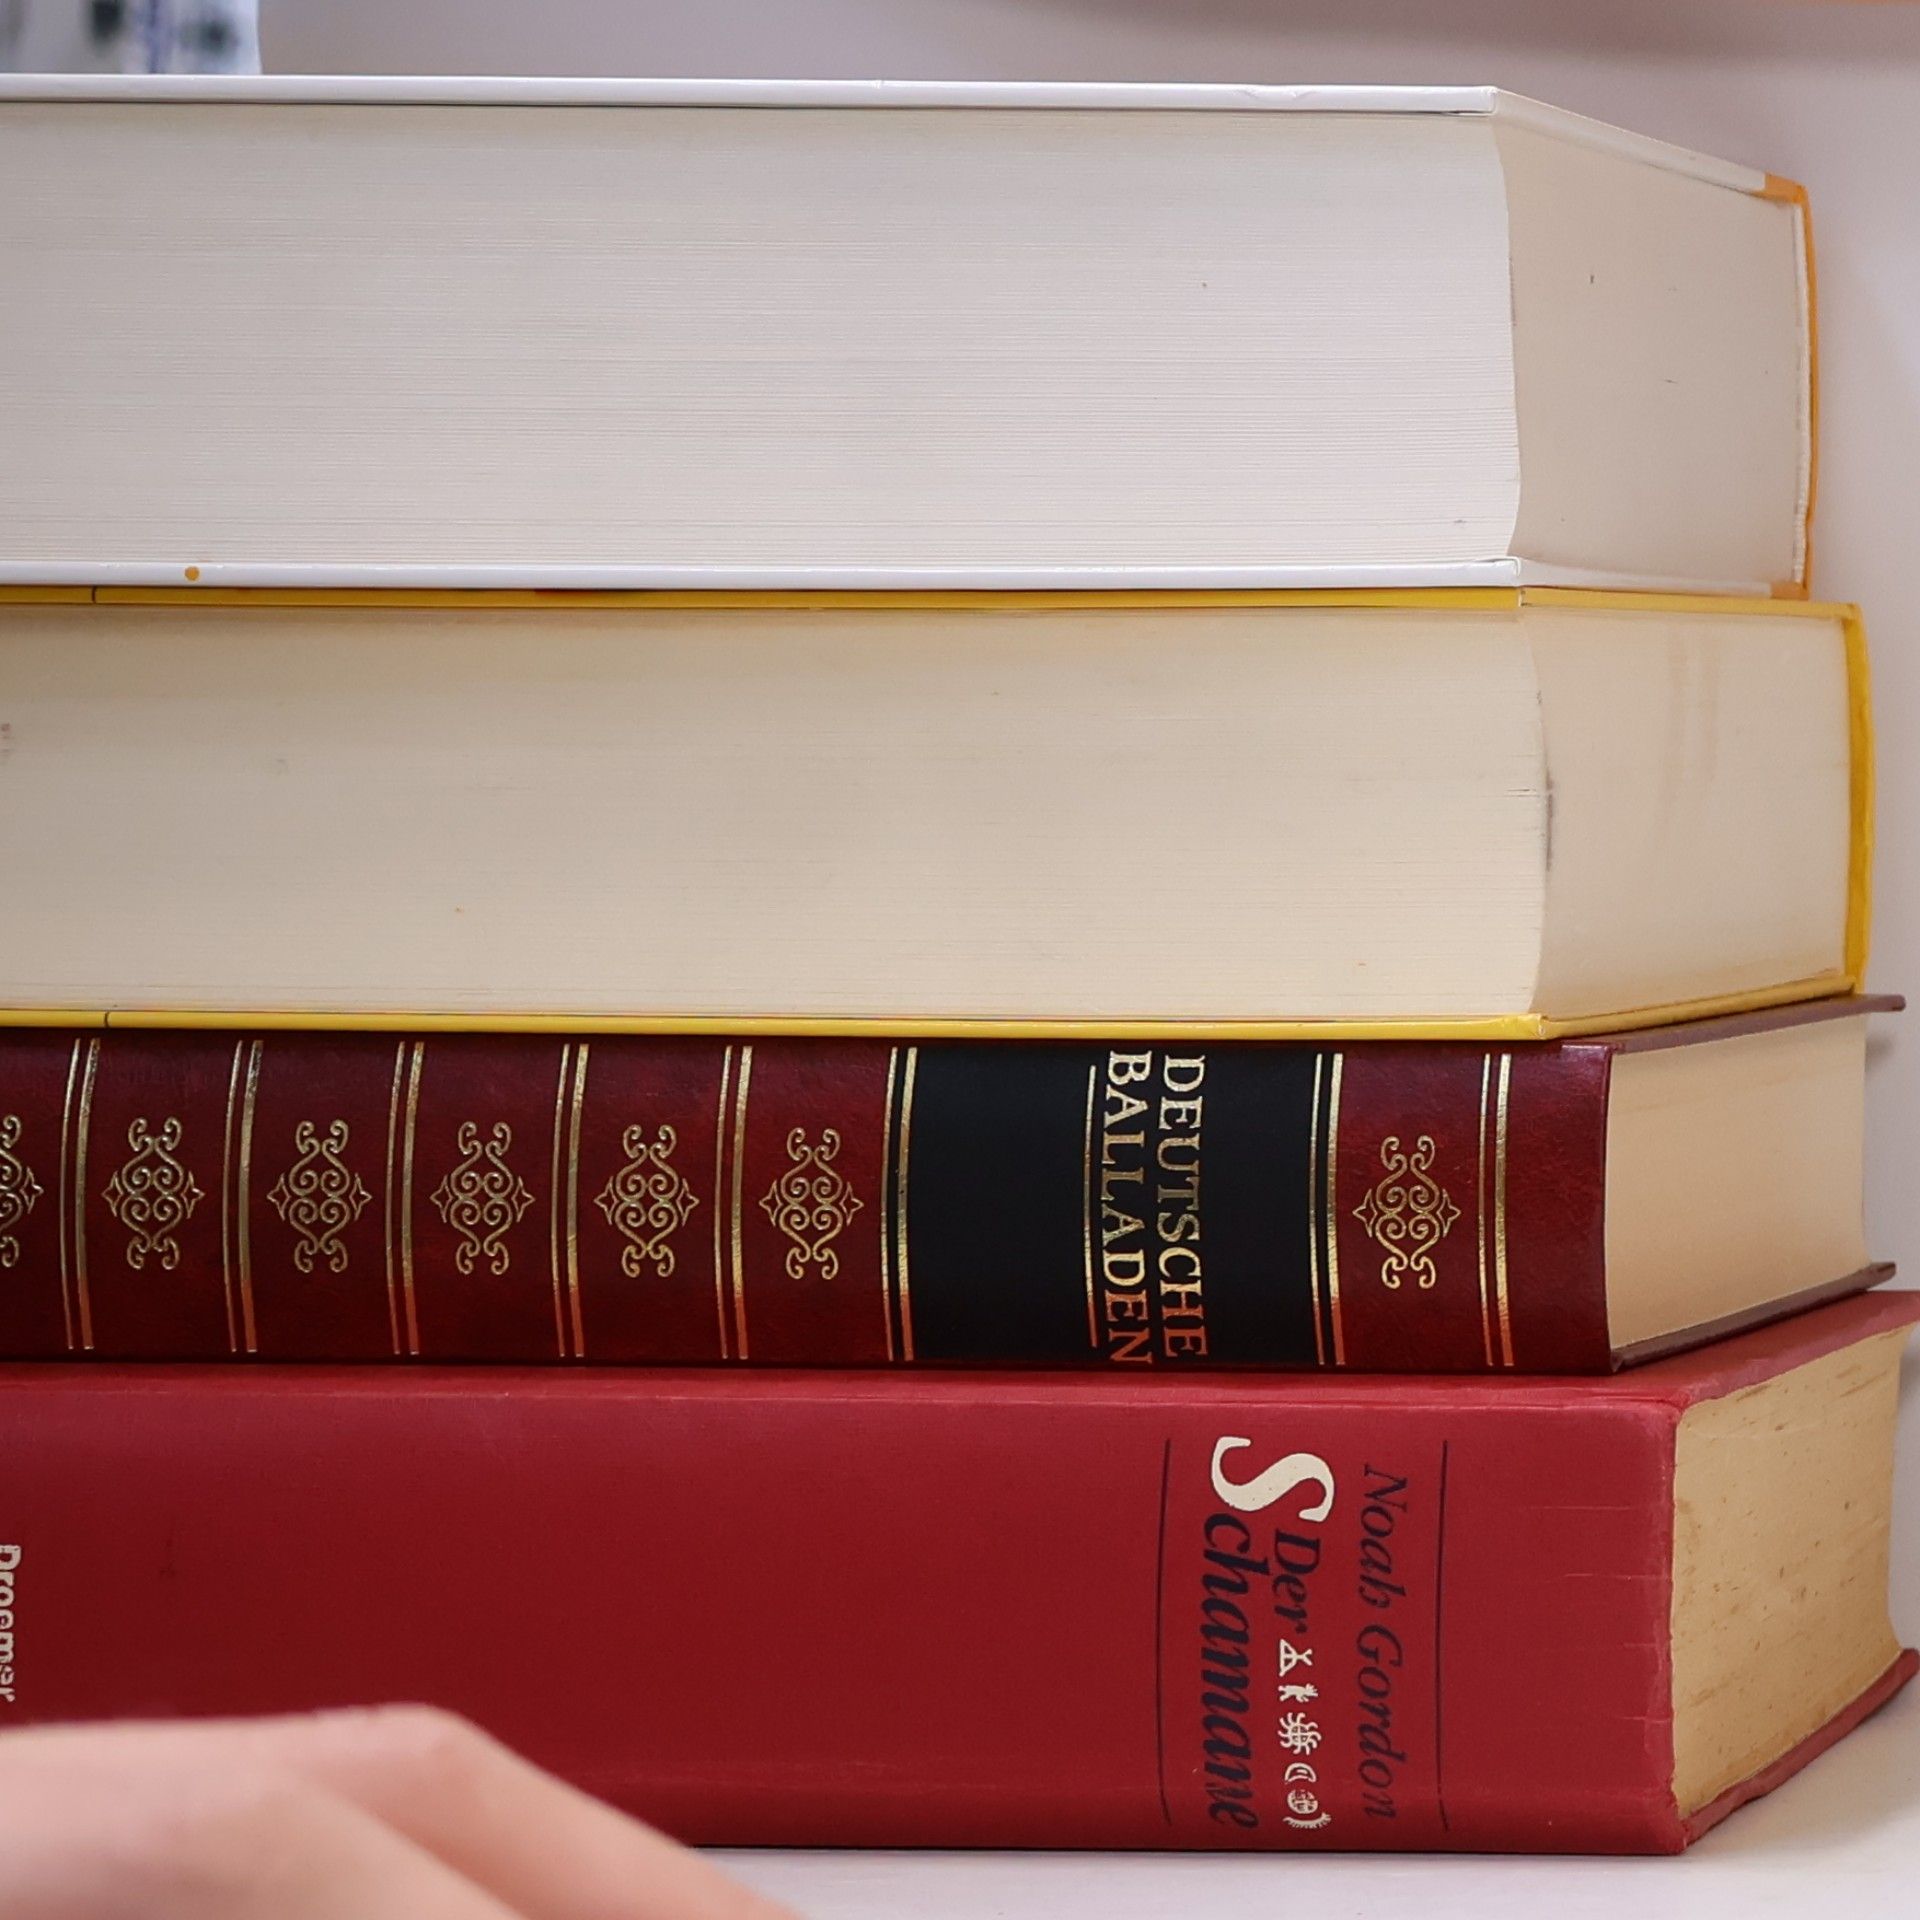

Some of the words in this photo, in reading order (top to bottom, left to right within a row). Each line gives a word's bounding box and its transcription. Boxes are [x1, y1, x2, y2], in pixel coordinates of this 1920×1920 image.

[1100, 1050, 1153, 1364] BALLADEN
[1156, 1054, 1208, 1358] DEUTSCHE
[1200, 1435, 1335, 1829] Schamane
[1272, 1527, 1321, 1634] Der
[1360, 1463, 1408, 1609] Noah
[1357, 1624, 1408, 1820] Gordon
